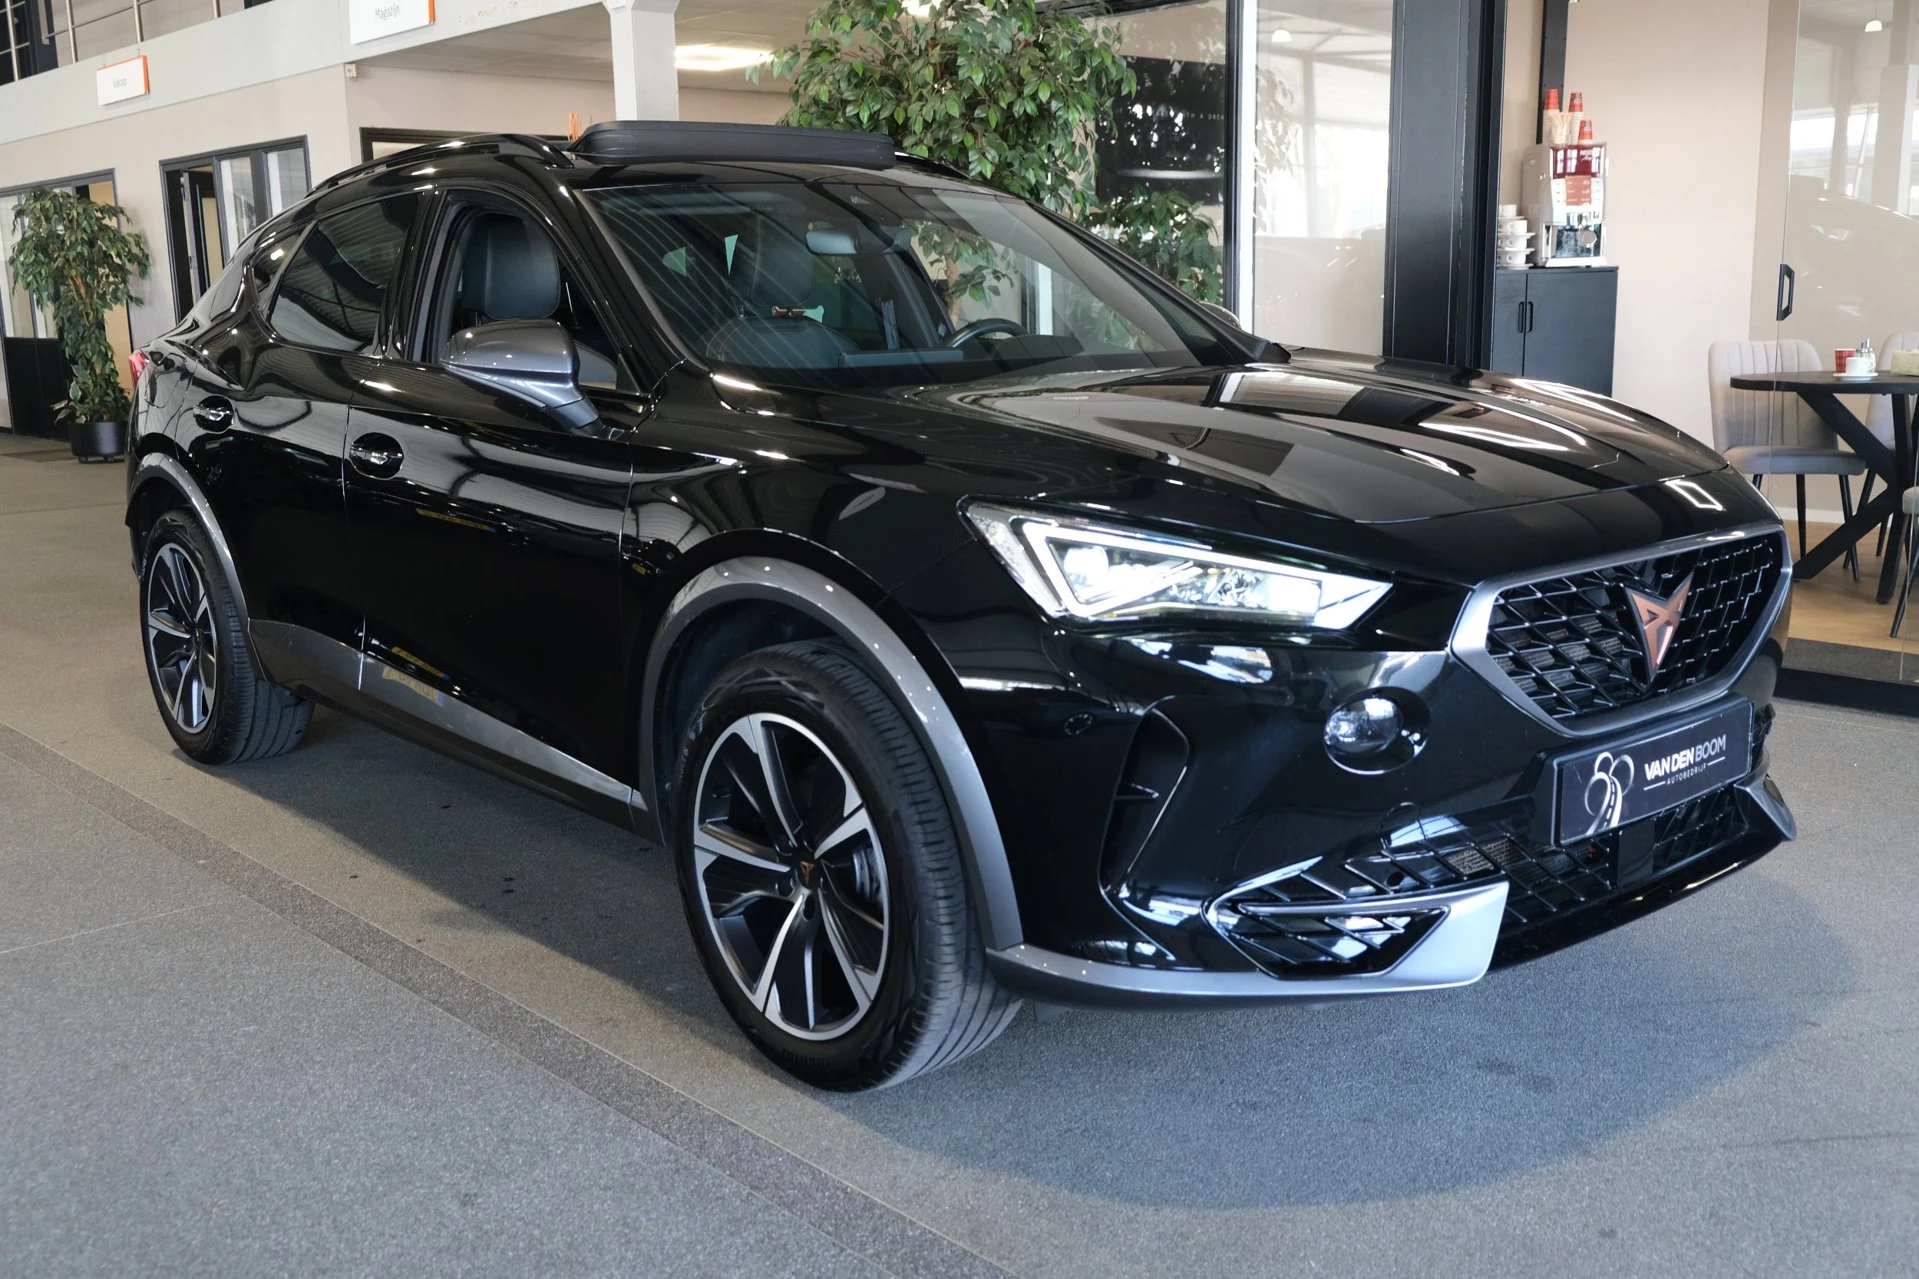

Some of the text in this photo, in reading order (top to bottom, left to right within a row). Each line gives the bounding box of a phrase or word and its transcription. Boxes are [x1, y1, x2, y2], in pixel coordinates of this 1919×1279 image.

[375, 3, 400, 21] Magazijn
[1645, 735, 1726, 780] VAN DEN BOOM
[1667, 763, 1707, 786] AUTOBEDRIJF
